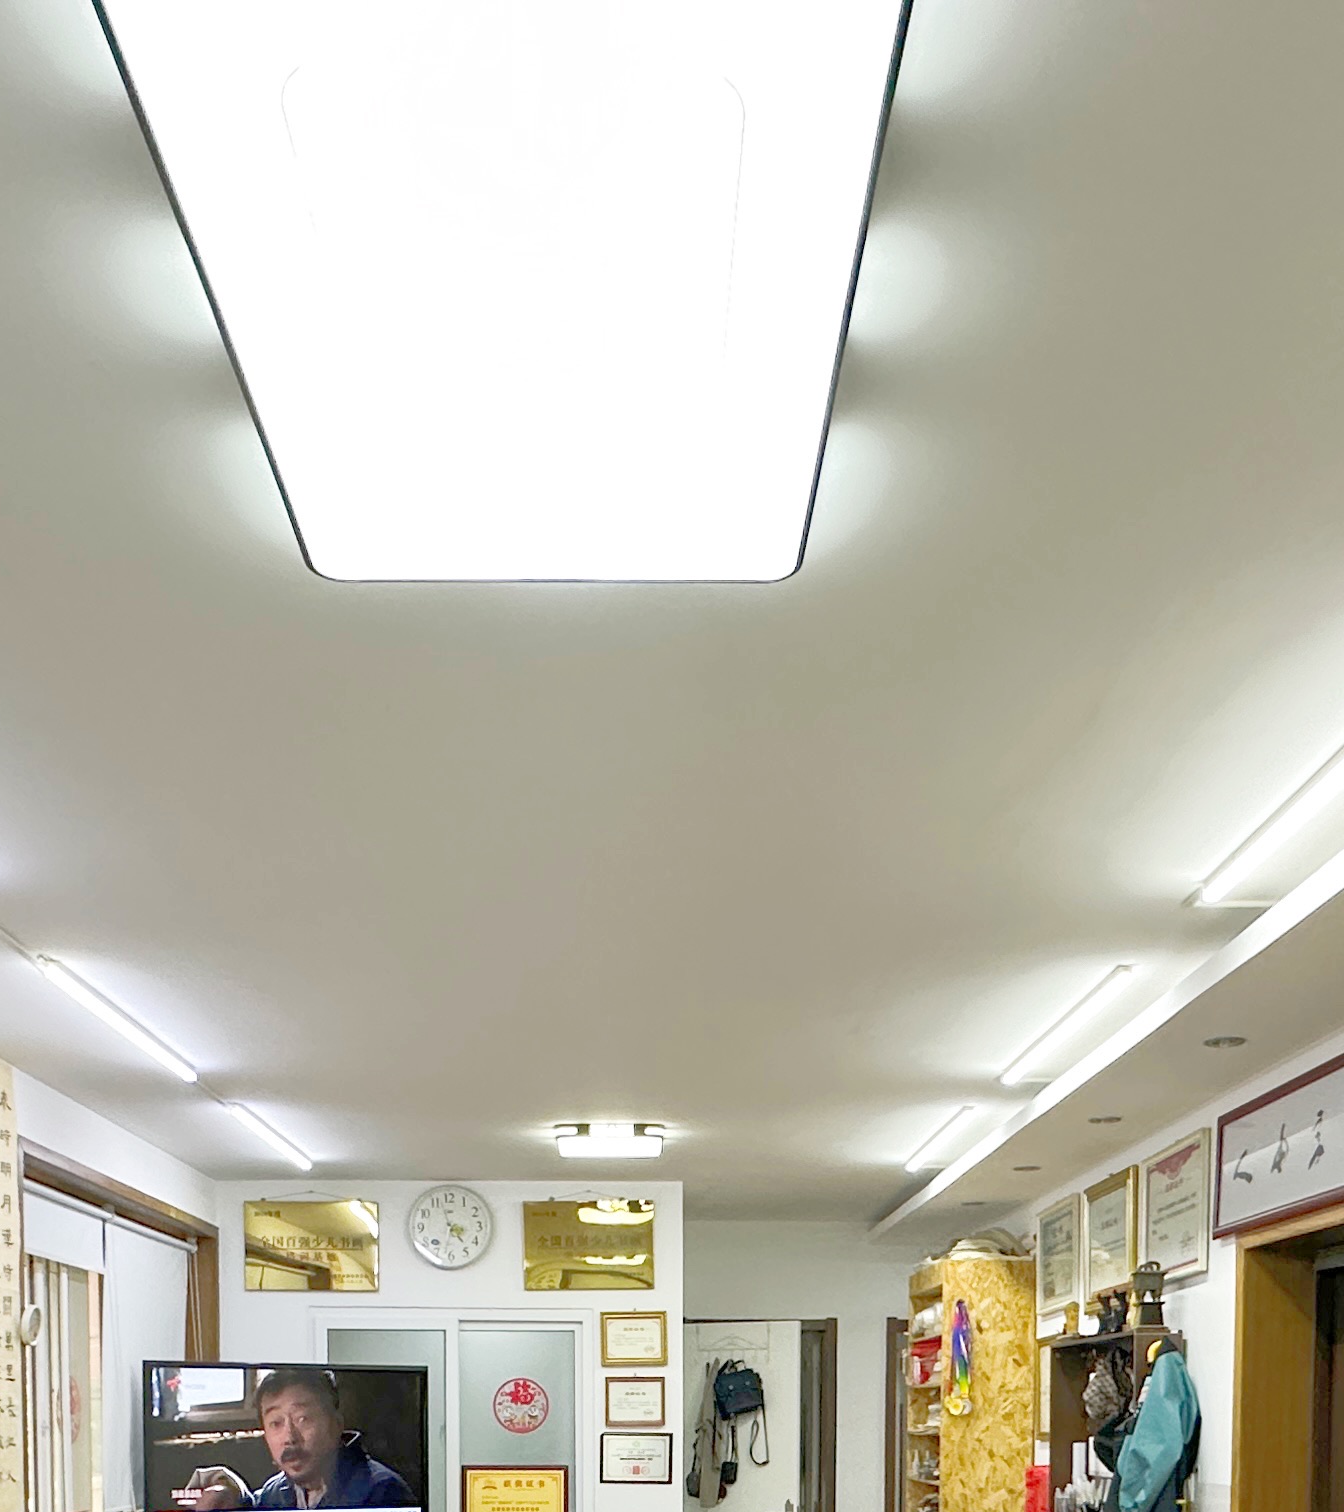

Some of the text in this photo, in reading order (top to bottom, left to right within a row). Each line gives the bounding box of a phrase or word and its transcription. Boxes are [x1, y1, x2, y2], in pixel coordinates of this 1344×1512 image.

[430, 1197, 440, 1209] 11
[443, 1192, 456, 1204] 12
[461, 1195, 467, 1208] 1
[420, 1208, 431, 1219] 10
[471, 1206, 480, 1218] 2
[417, 1221, 425, 1233] 9
[476, 1220, 484, 1232] 3
[471, 1235, 479, 1247] 4
[447, 1250, 456, 1263] 6
[461, 1246, 470, 1258] 5
